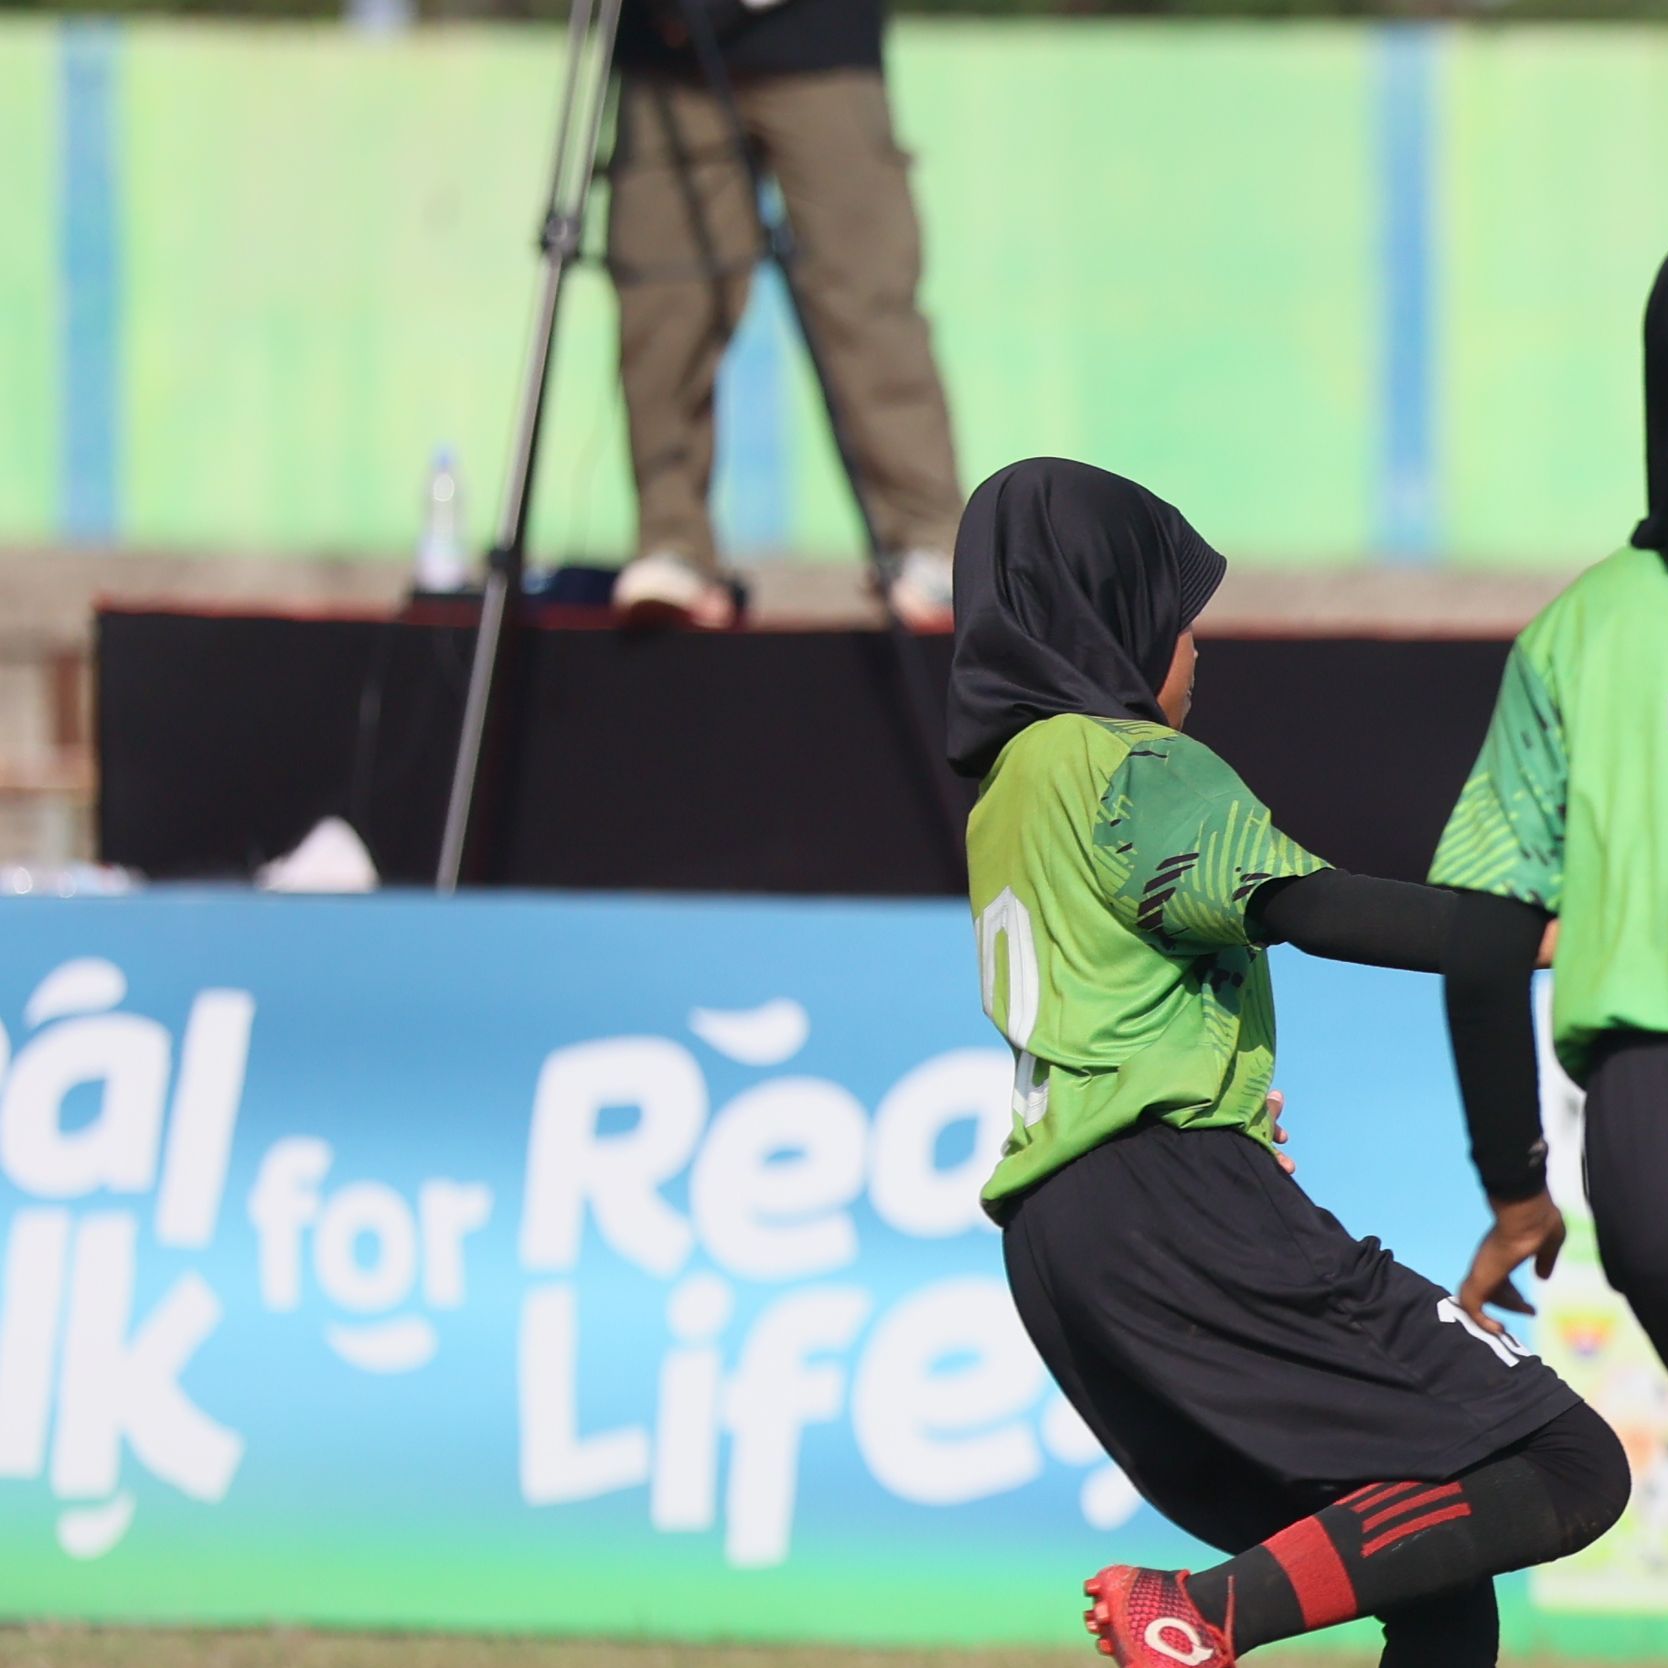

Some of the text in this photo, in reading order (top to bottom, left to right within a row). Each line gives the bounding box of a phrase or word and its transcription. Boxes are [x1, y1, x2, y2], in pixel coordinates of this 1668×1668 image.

[0, 962, 255, 1248] al
[250, 1136, 493, 1312] for
[519, 1005, 1005, 1280] Rea
[0, 1208, 248, 1502] lk
[519, 1272, 1045, 1568] Life
